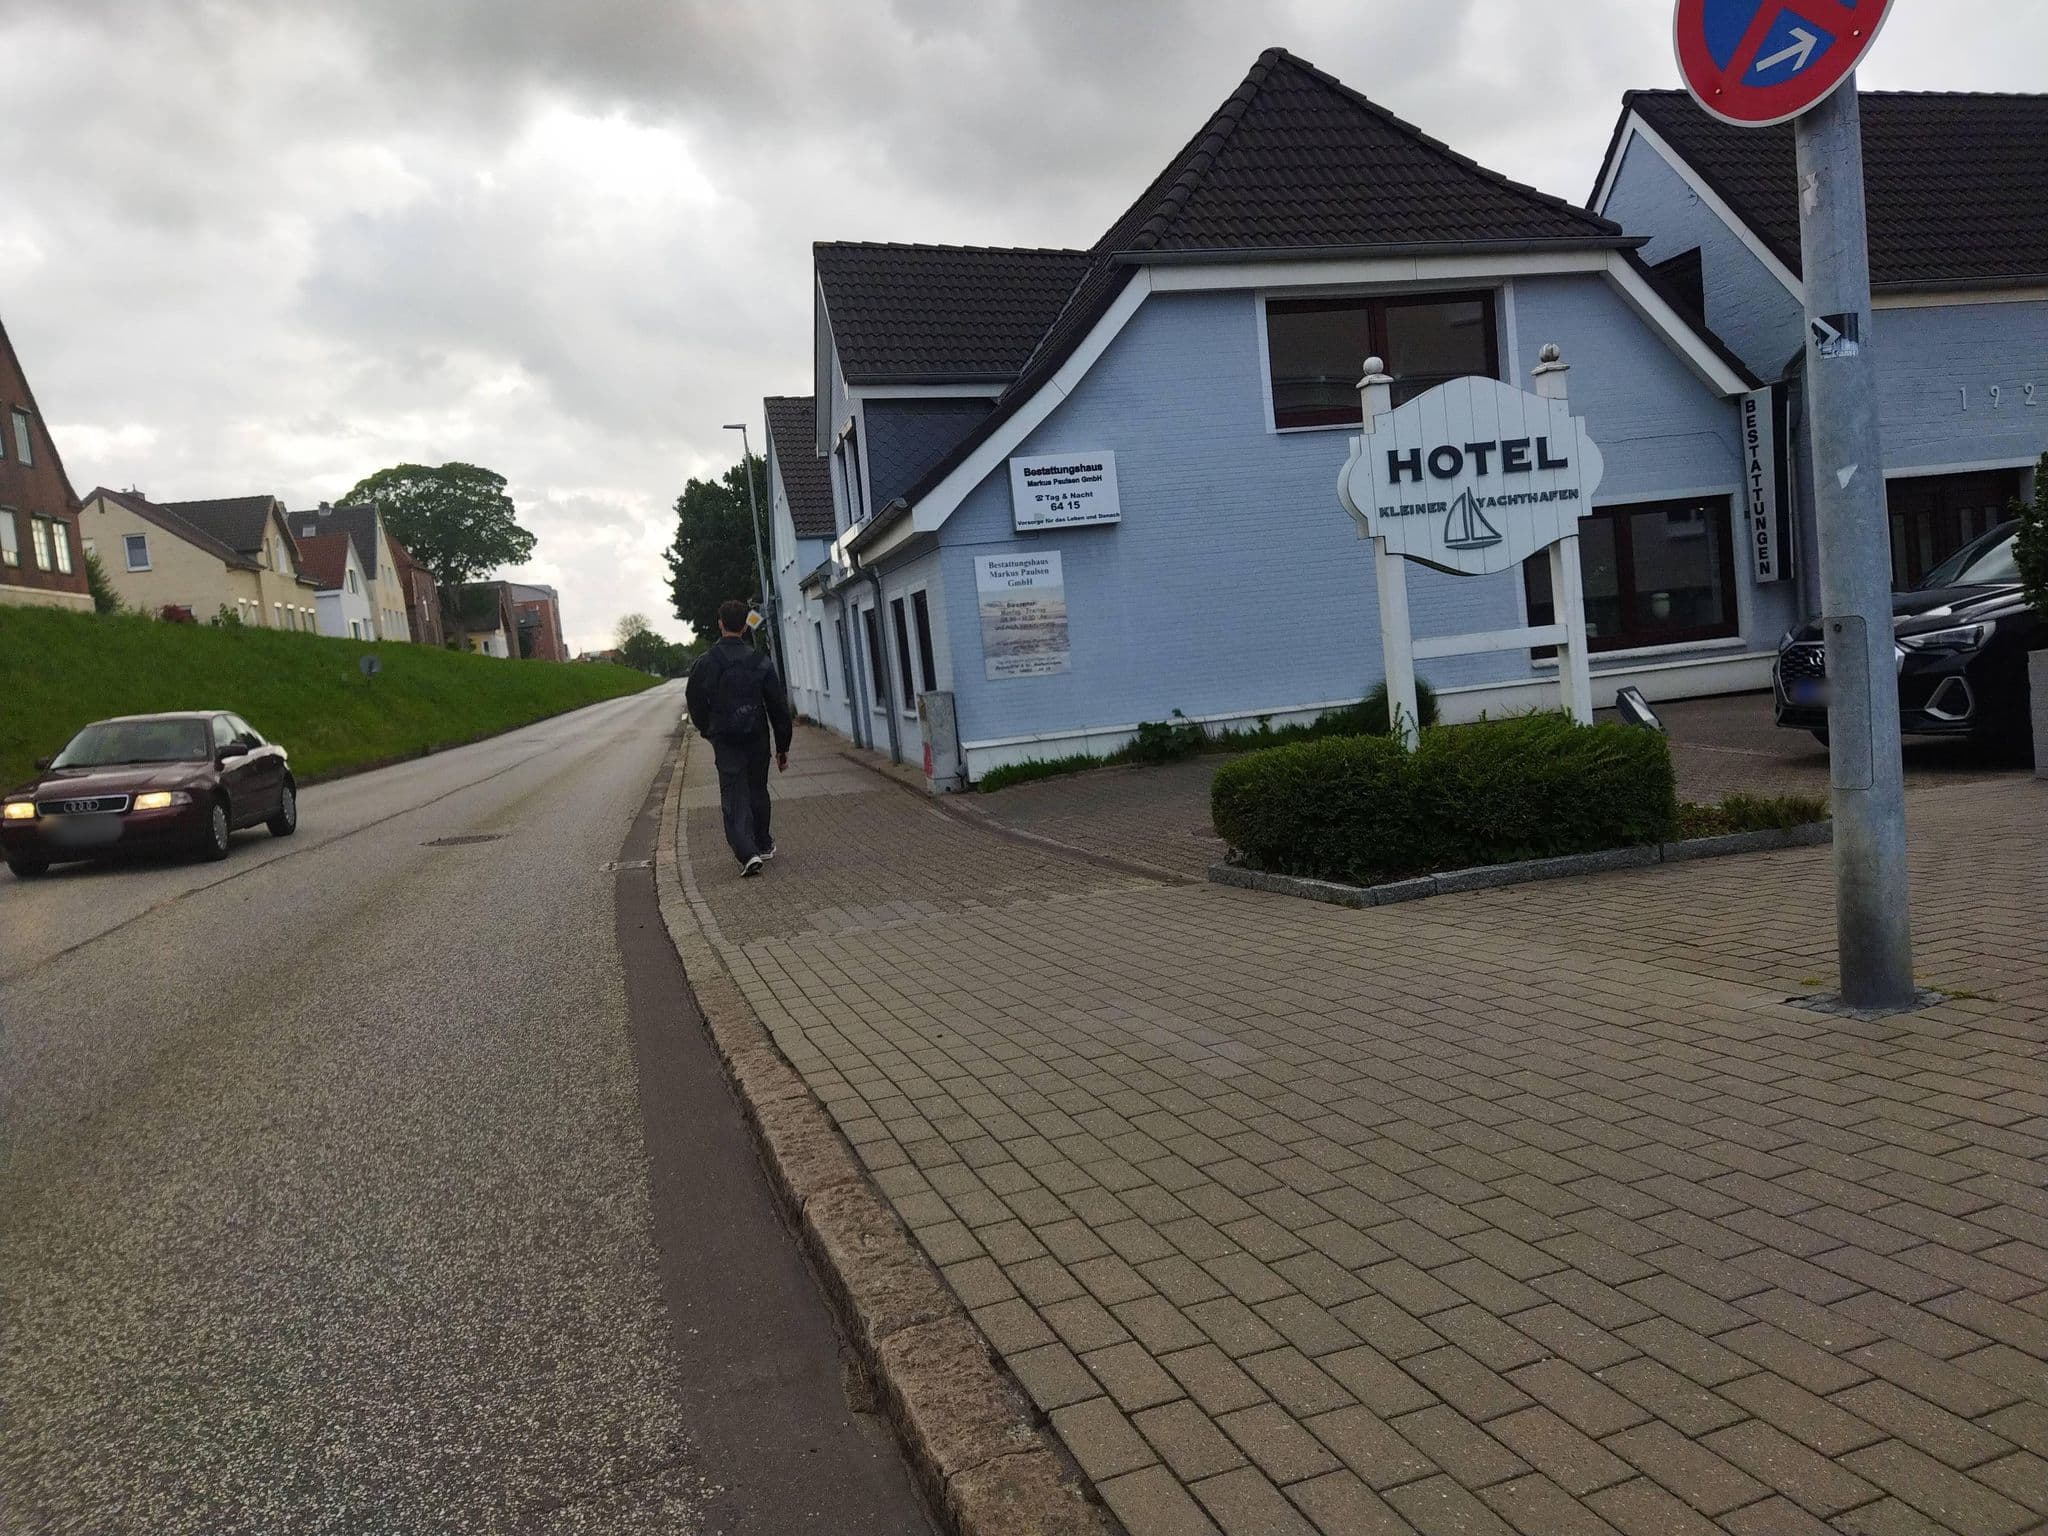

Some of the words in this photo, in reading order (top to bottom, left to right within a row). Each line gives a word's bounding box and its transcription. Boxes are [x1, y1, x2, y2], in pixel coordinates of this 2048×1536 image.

[1387, 437, 1568, 484] HOTEL
[1023, 463, 1103, 477] Bestattungshaus
[1027, 479, 1052, 487] Markus
[1745, 399, 1771, 575] BESTATTUNGEN
[1045, 494, 1060, 502] Tag
[1070, 491, 1094, 499] Nacht
[1050, 502, 1064, 511] 64
[1067, 501, 1081, 510] 15
[1379, 501, 1447, 518] KLEINER
[1476, 488, 1579, 508] YACHTHAFEN
[1017, 518, 1044, 526] Vorsorge
[1067, 514, 1085, 522] Leben
[988, 558, 1049, 569] Bestattungshaus
[990, 569, 1019, 578] Markus
[1021, 567, 1050, 577] Paulsen
[1007, 578, 1033, 587] GmbH
